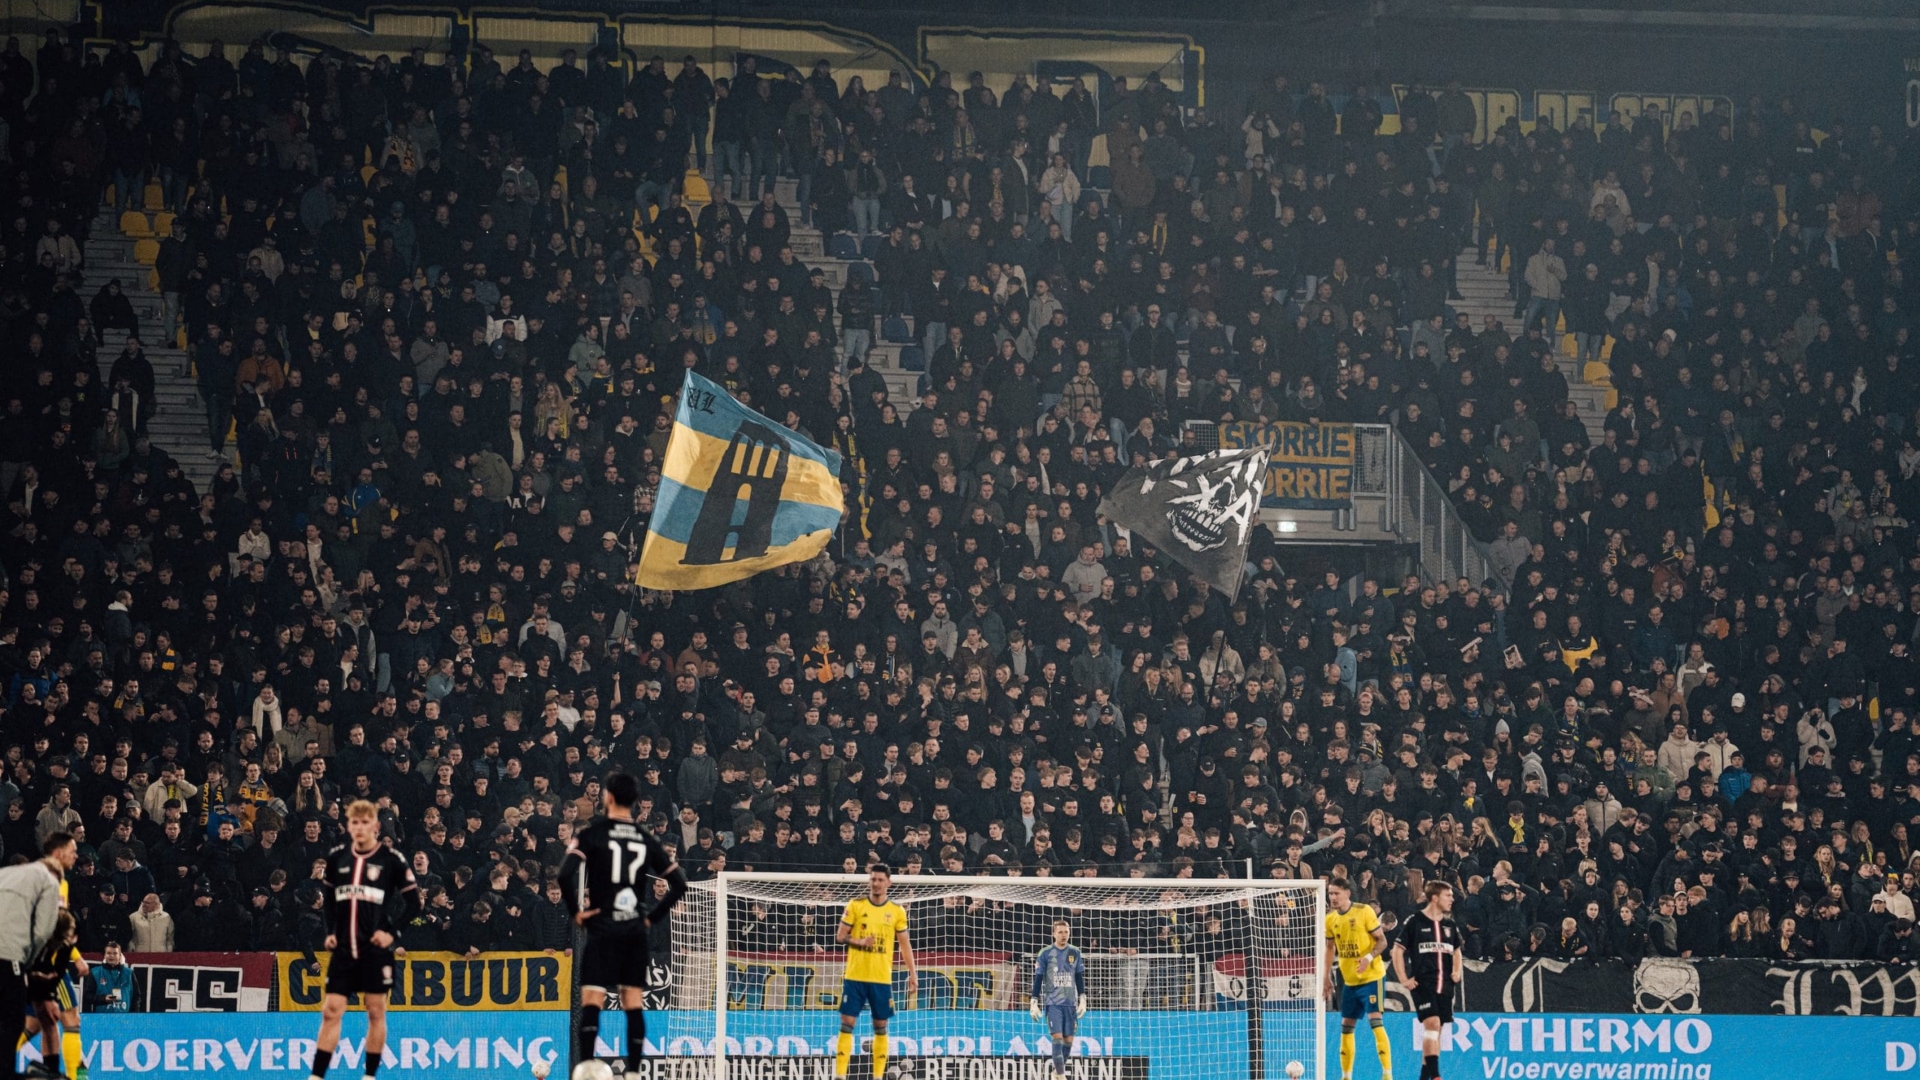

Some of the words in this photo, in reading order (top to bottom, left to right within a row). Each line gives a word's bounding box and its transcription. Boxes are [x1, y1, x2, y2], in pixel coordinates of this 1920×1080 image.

[1226, 423, 1350, 458] SKORRIE
[1261, 467, 1350, 499] ORRIE
[608, 840, 647, 885] 17
[288, 957, 559, 1006] CBUUR
[1482, 1056, 1713, 1080] Vloerverwarming
[1885, 1041, 1920, 1072] D
